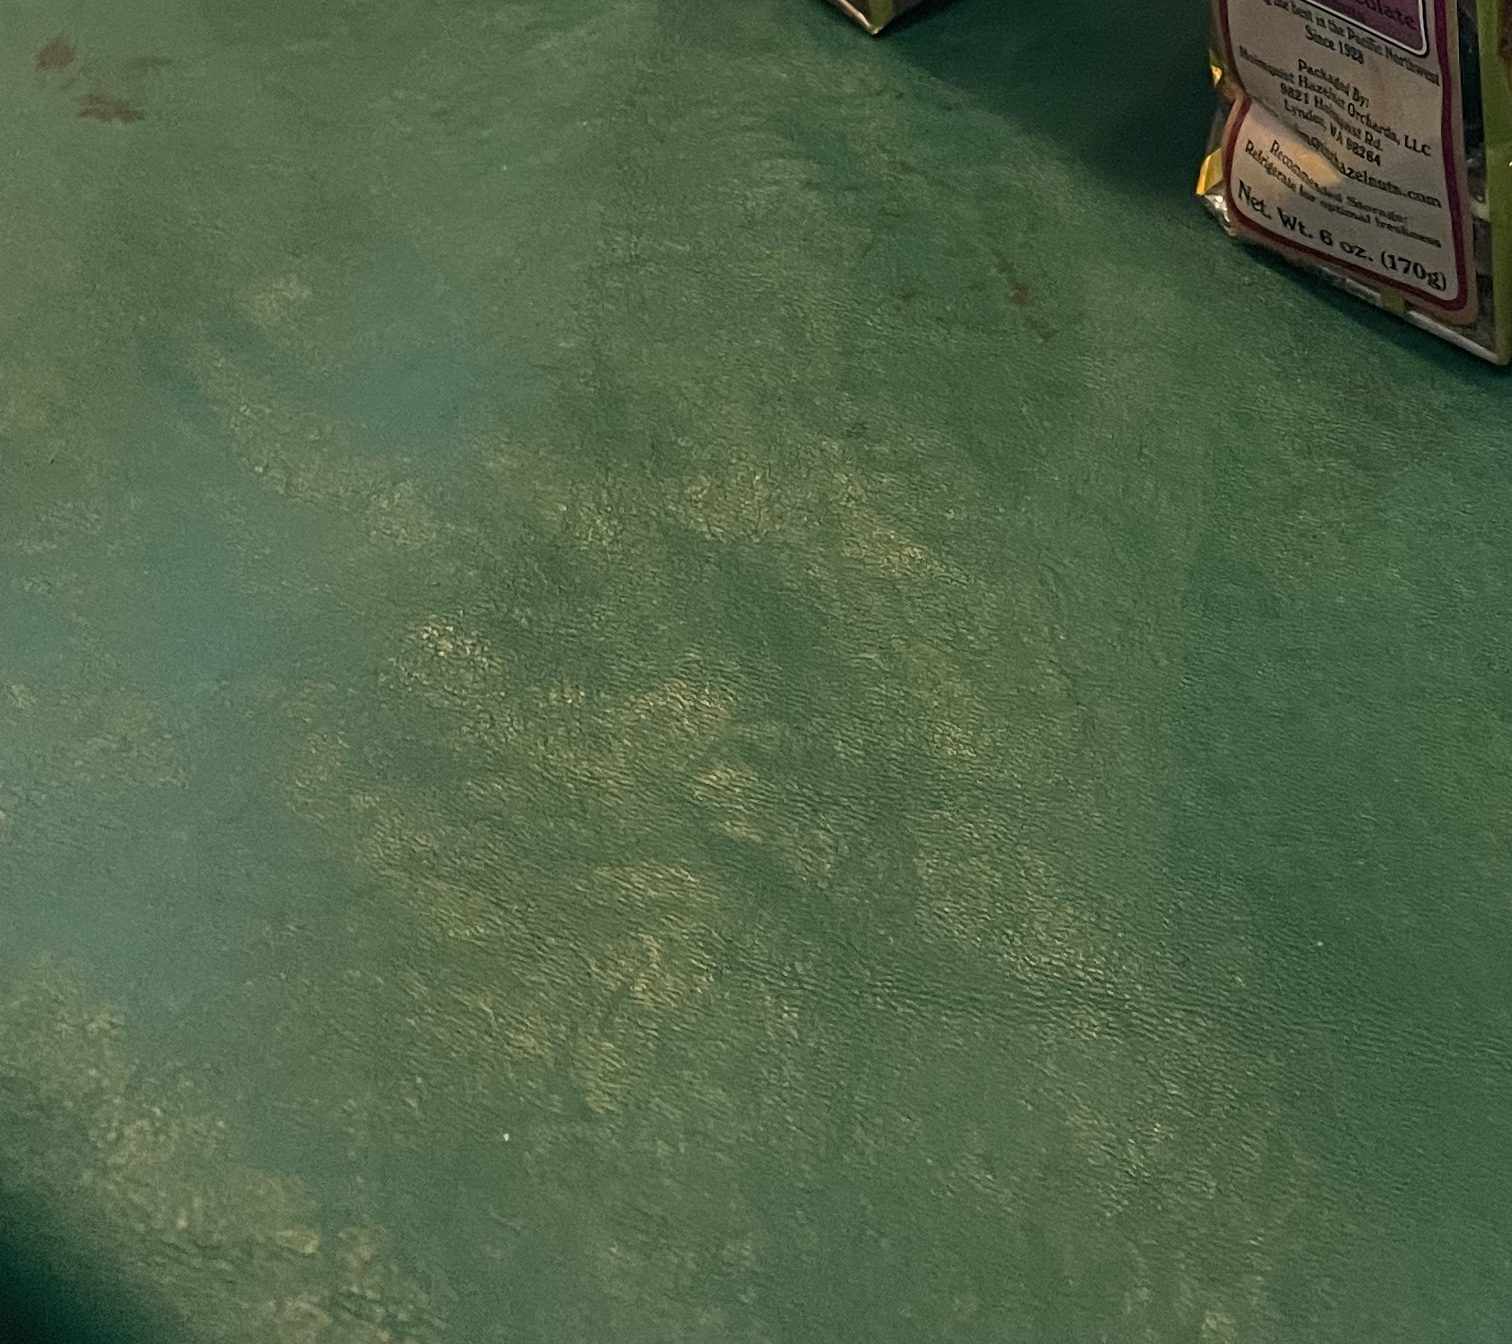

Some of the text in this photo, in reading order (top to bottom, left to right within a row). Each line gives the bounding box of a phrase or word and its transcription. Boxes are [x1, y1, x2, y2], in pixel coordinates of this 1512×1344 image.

[1304, 23, 1336, 52] Since
[1385, 44, 1441, 87] Northwest
[1403, 133, 1433, 158] LLC
[1276, 206, 1314, 240] Wt.
[1318, 228, 1335, 247] 6
[1339, 240, 1375, 262] oz.
[1380, 249, 1447, 292] (170g)
